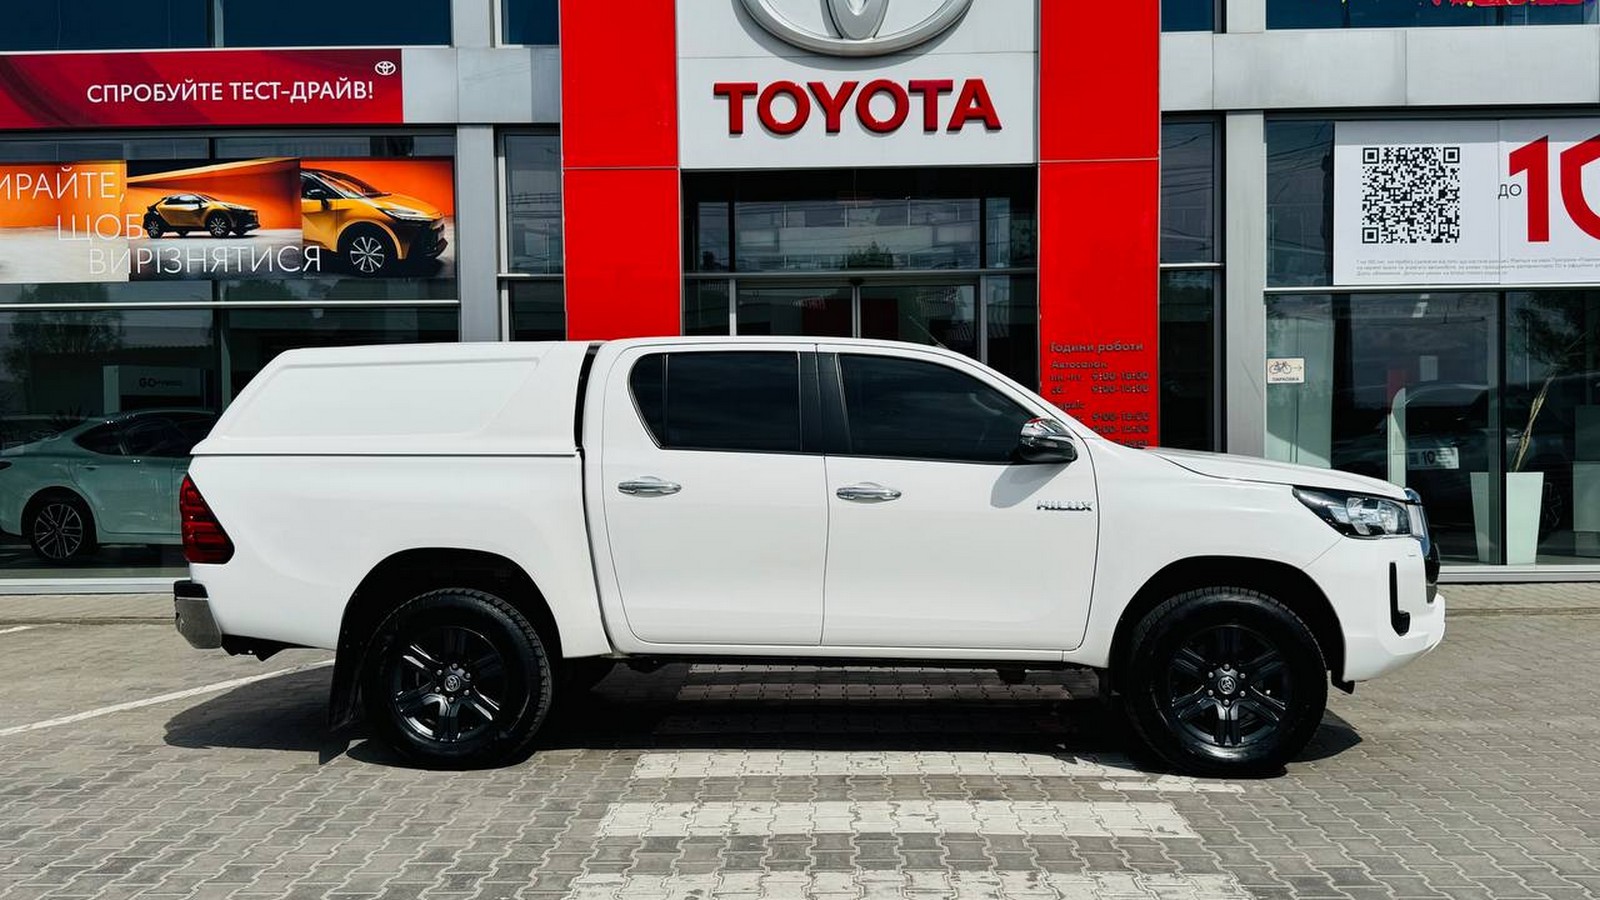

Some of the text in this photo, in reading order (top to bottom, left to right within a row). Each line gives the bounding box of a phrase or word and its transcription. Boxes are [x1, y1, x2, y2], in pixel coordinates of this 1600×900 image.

[87, 76, 375, 104] СПРОБУЙТЕ ТЕСТ-ДРАЙВ!
[713, 78, 1002, 134] TOYOTA
[57, 211, 144, 248] ЩОБ
[89, 245, 322, 276] ВИРІЗНЯТИСЯ
[1050, 340, 1144, 354] Години роботи
